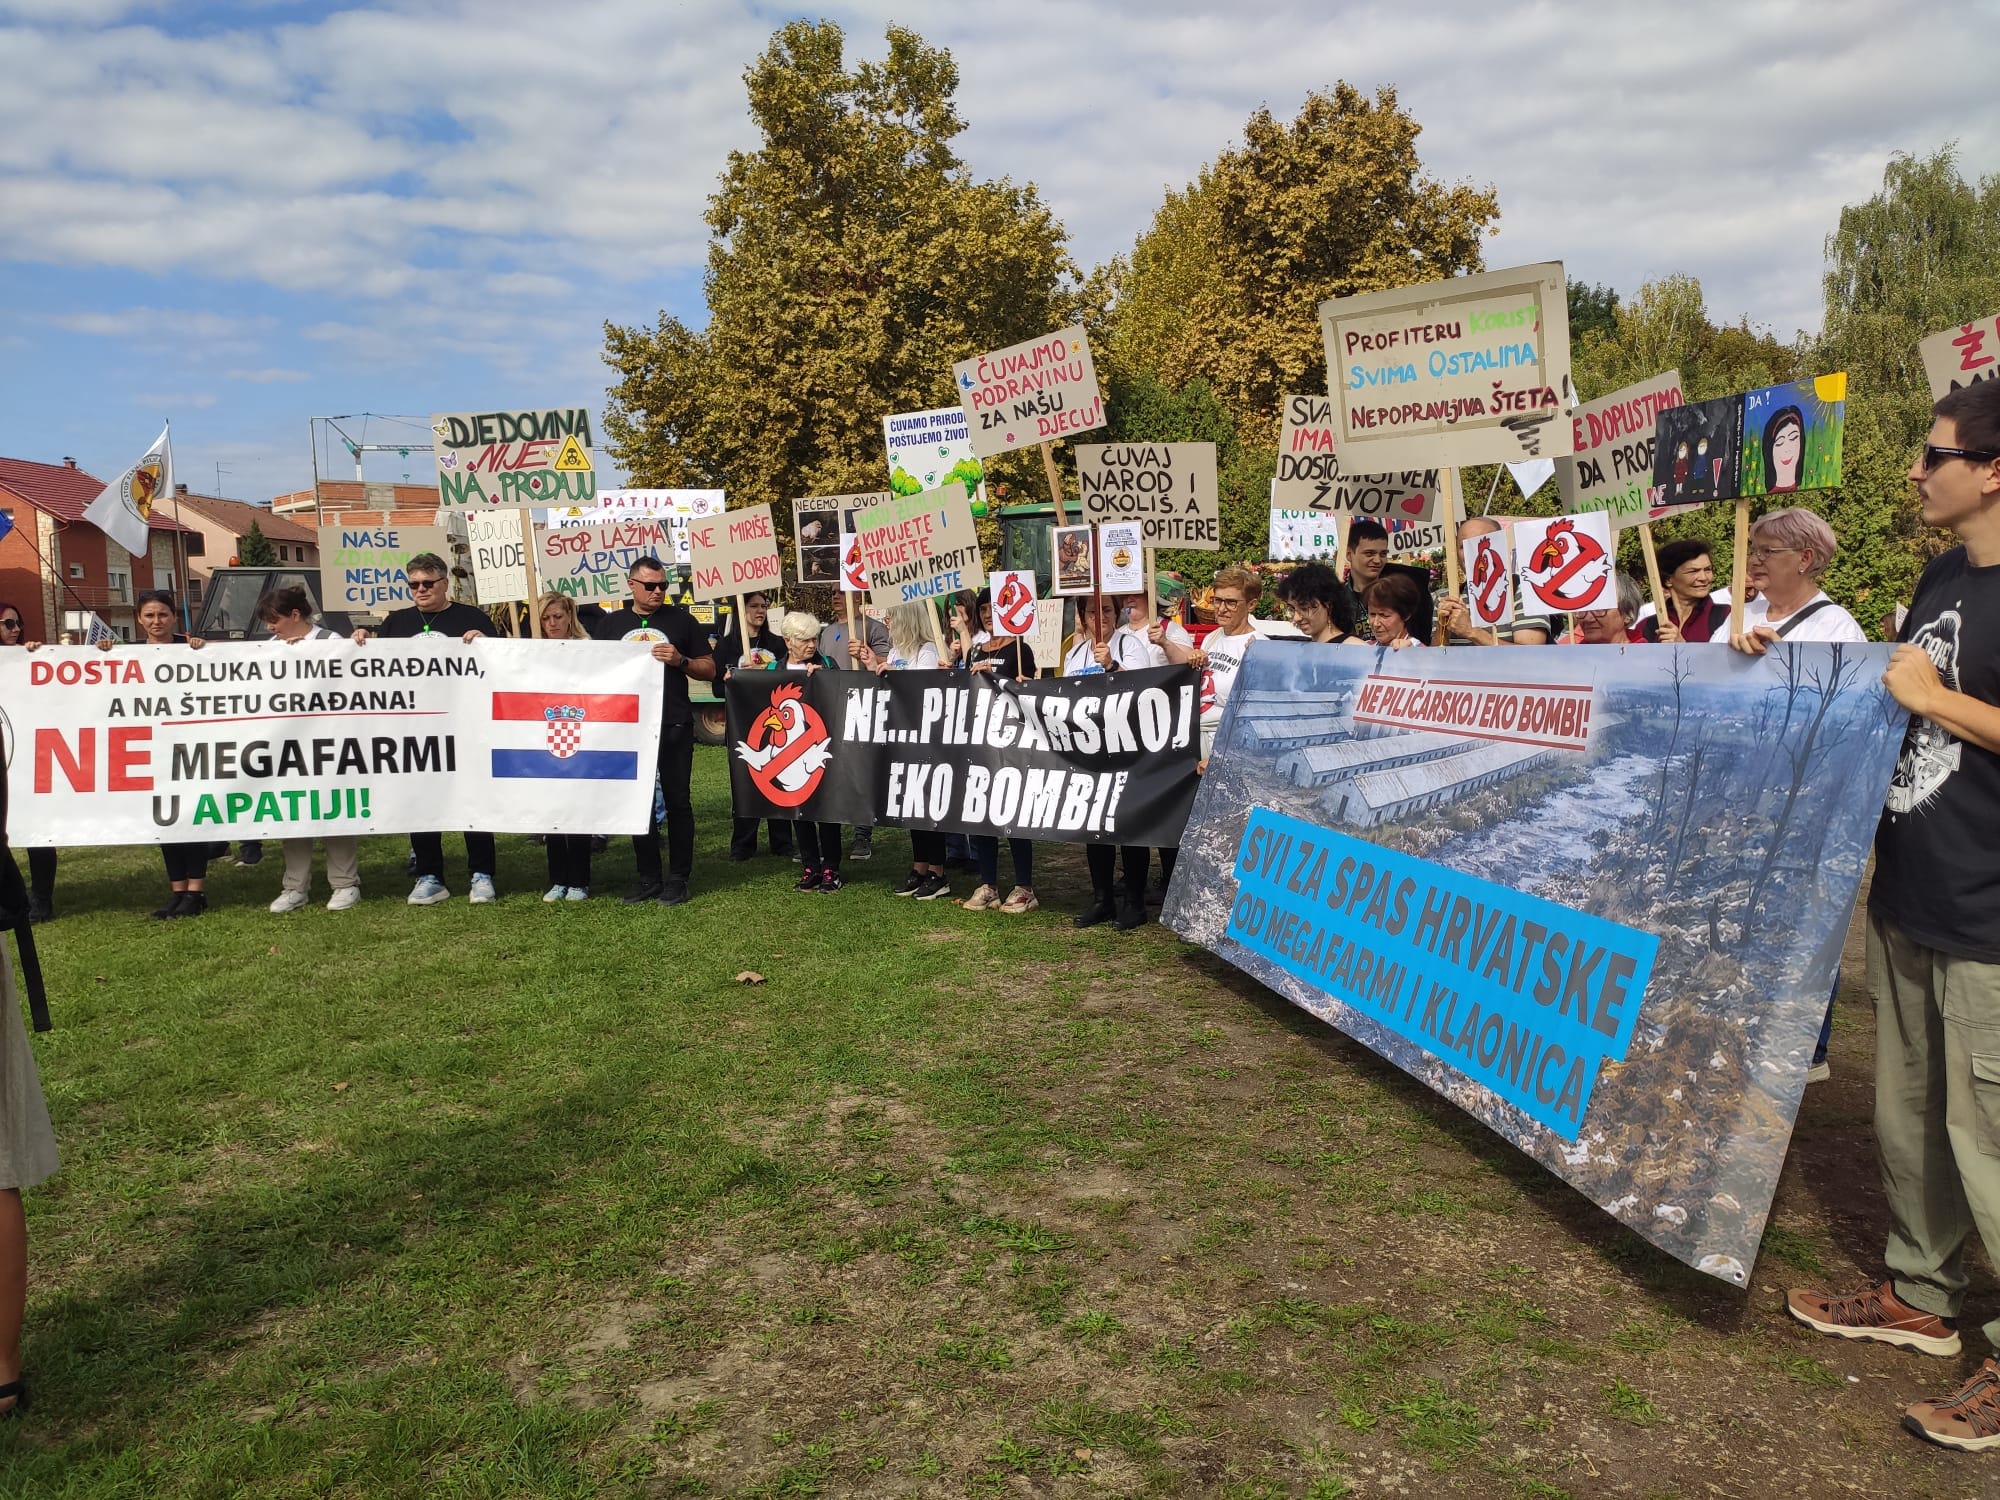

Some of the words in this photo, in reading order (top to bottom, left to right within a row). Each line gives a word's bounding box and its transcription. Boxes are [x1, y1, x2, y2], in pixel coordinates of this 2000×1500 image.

[1345, 321, 1461, 356] PROFITERU
[1951, 322, 2000, 371] Ž
[977, 339, 1066, 384] ČUVAJMO
[1349, 362, 1417, 390] SVIMA
[1428, 342, 1537, 378] OSTALIMA
[971, 360, 1084, 411] PODRAVINU
[890, 416, 927, 432] ČUVAMO
[980, 409, 1007, 430] ZA
[1013, 390, 1064, 420] NAŠU
[1037, 395, 1102, 437] DJECU!
[442, 408, 593, 448] DJEDOVINA
[889, 431, 942, 448] POŠTUJEMO
[1292, 428, 1334, 452] IMA
[1573, 416, 1588, 453] E
[475, 440, 560, 473] NIJE
[1101, 445, 1171, 468] ČUVAJ
[1577, 457, 1605, 489] DA
[440, 470, 489, 506] NA
[498, 469, 596, 502] PRODAJU
[1082, 469, 1173, 493] NAROD
[1190, 472, 1195, 494] I
[1309, 481, 1405, 514] ŽIVOT
[588, 495, 674, 509] PATIJA
[1185, 498, 1200, 514] A
[342, 528, 400, 548] NAŠE
[545, 531, 592, 556] STOP
[691, 528, 716, 549] NE
[729, 514, 772, 544] MIRIŠE
[862, 514, 933, 551] KUPUJETE
[1121, 516, 1218, 541] OFITERE
[1393, 524, 1448, 550] ODUST
[333, 549, 431, 566] ZDRAV
[865, 537, 933, 569] TRUJETE
[871, 560, 924, 589] PRLJAVI
[928, 545, 977, 574] PROFIT
[345, 568, 409, 584] NEMA
[479, 573, 528, 599] ZELEN
[547, 576, 588, 598] VAM
[593, 573, 620, 597] NE
[696, 566, 724, 589] NA
[732, 554, 781, 583] DOBRO
[901, 570, 963, 602] SNUJETE
[30, 660, 146, 686] DOSTA
[154, 661, 263, 683] ODLUKA
[270, 660, 287, 680] U
[296, 659, 344, 680] IME
[350, 657, 486, 680] GRAĐANA,
[108, 698, 126, 718] A
[133, 697, 173, 717] NA
[180, 692, 262, 716] ŠTETU
[268, 690, 416, 713] GRAĐANA!
[1356, 684, 1384, 713] NE
[1479, 693, 1518, 730] EKO
[1517, 695, 1592, 738] BOMBI!
[33, 726, 155, 794] NE
[171, 735, 457, 781] MEGAFARMI
[152, 795, 181, 827] U
[192, 787, 372, 825] APATIJI!
[886, 763, 953, 822] EKO
[961, 765, 1129, 833] BOMBI!
[1242, 825, 1289, 885] SVI
[1287, 840, 1330, 902] ZA
[1326, 856, 1417, 936] SPAS
[1412, 886, 1639, 1040] HRVATSKE
[1233, 893, 1268, 936] OD
[1263, 911, 1408, 1016] MEGAFARMI
[1404, 974, 1424, 1024] I
[1420, 980, 1587, 1123] KLAONICA
